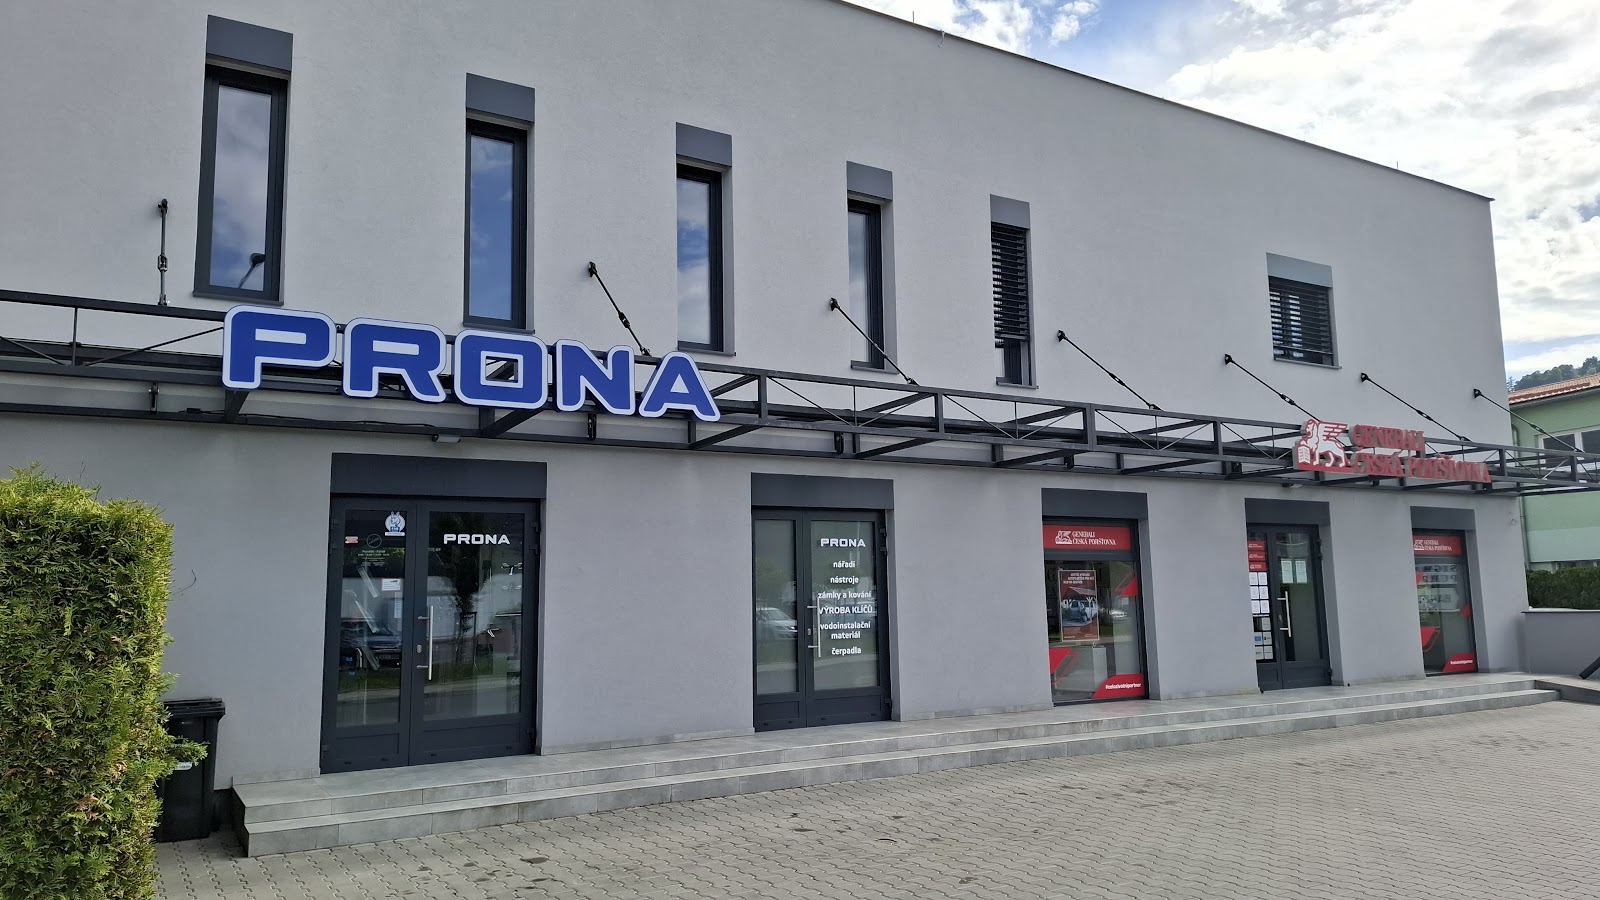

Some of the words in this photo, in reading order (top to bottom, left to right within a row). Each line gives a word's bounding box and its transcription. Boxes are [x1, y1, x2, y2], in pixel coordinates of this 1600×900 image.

[222, 305, 721, 422] PRONA
[1351, 424, 1425, 451] GENERALI
[443, 533, 510, 544] PRONA
[820, 538, 866, 547] PRONA
[833, 560, 856, 568] nářadí
[830, 576, 859, 584] nástroje
[818, 591, 841, 600] zámky
[848, 591, 872, 599] kování
[819, 605, 850, 615] VÝROBA
[851, 604, 873, 613] KLÍČŮ
[820, 621, 870, 629] vodoinstalační
[831, 631, 860, 639] materiál
[831, 646, 862, 656] čerpadla
